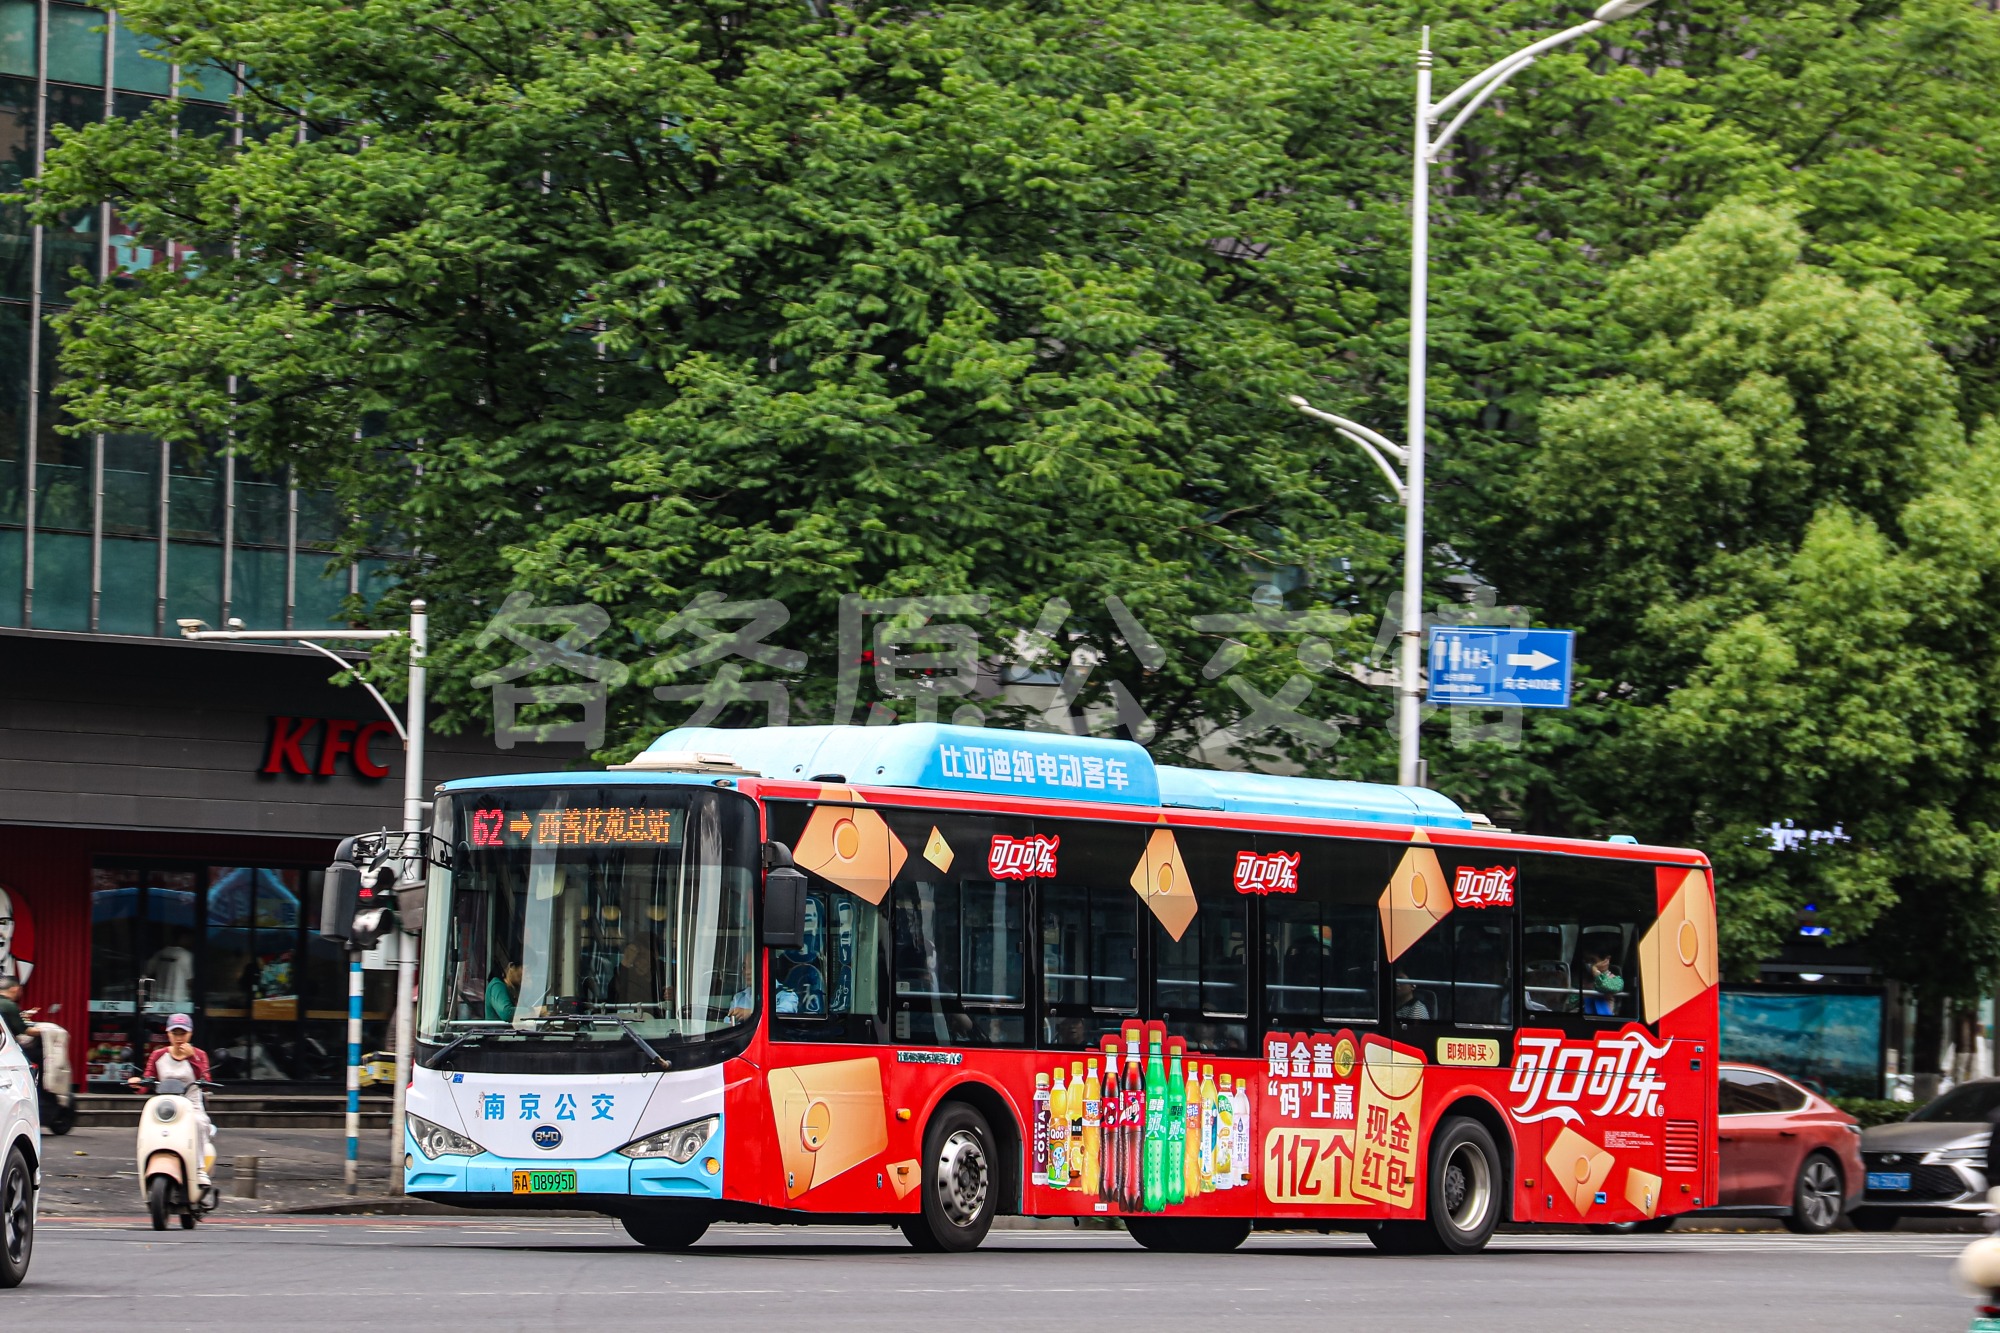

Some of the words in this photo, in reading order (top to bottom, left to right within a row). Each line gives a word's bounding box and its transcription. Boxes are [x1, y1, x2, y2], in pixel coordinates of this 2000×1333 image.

[262, 716, 394, 778] KFC
[939, 744, 1129, 791] 比亚迪纯电动客车
[472, 809, 504, 845] 62
[538, 807, 671, 844] 西善花苑总站
[991, 838, 1058, 875] 可口可乐
[1236, 855, 1298, 890] 可口可乐
[1456, 870, 1515, 904] 可口可乐
[1268, 1040, 1334, 1079] 揭金盖
[1446, 1042, 1487, 1062] 即刻购买
[1509, 1031, 1674, 1126] 可口可乐
[484, 1093, 614, 1121] 南京公交
[1148, 1098, 1165, 1111] 雪碧
[1267, 1080, 1354, 1120] “码”上赢
[535, 1131, 559, 1142] BYD
[1037, 1111, 1046, 1163] COSTA
[1051, 1129, 1064, 1140] Qoo
[1364, 1103, 1413, 1154] 现金
[533, 1174, 575, 1190] 08995D
[1270, 1134, 1354, 1198] 1亿个
[1360, 1147, 1408, 1199] 红包
